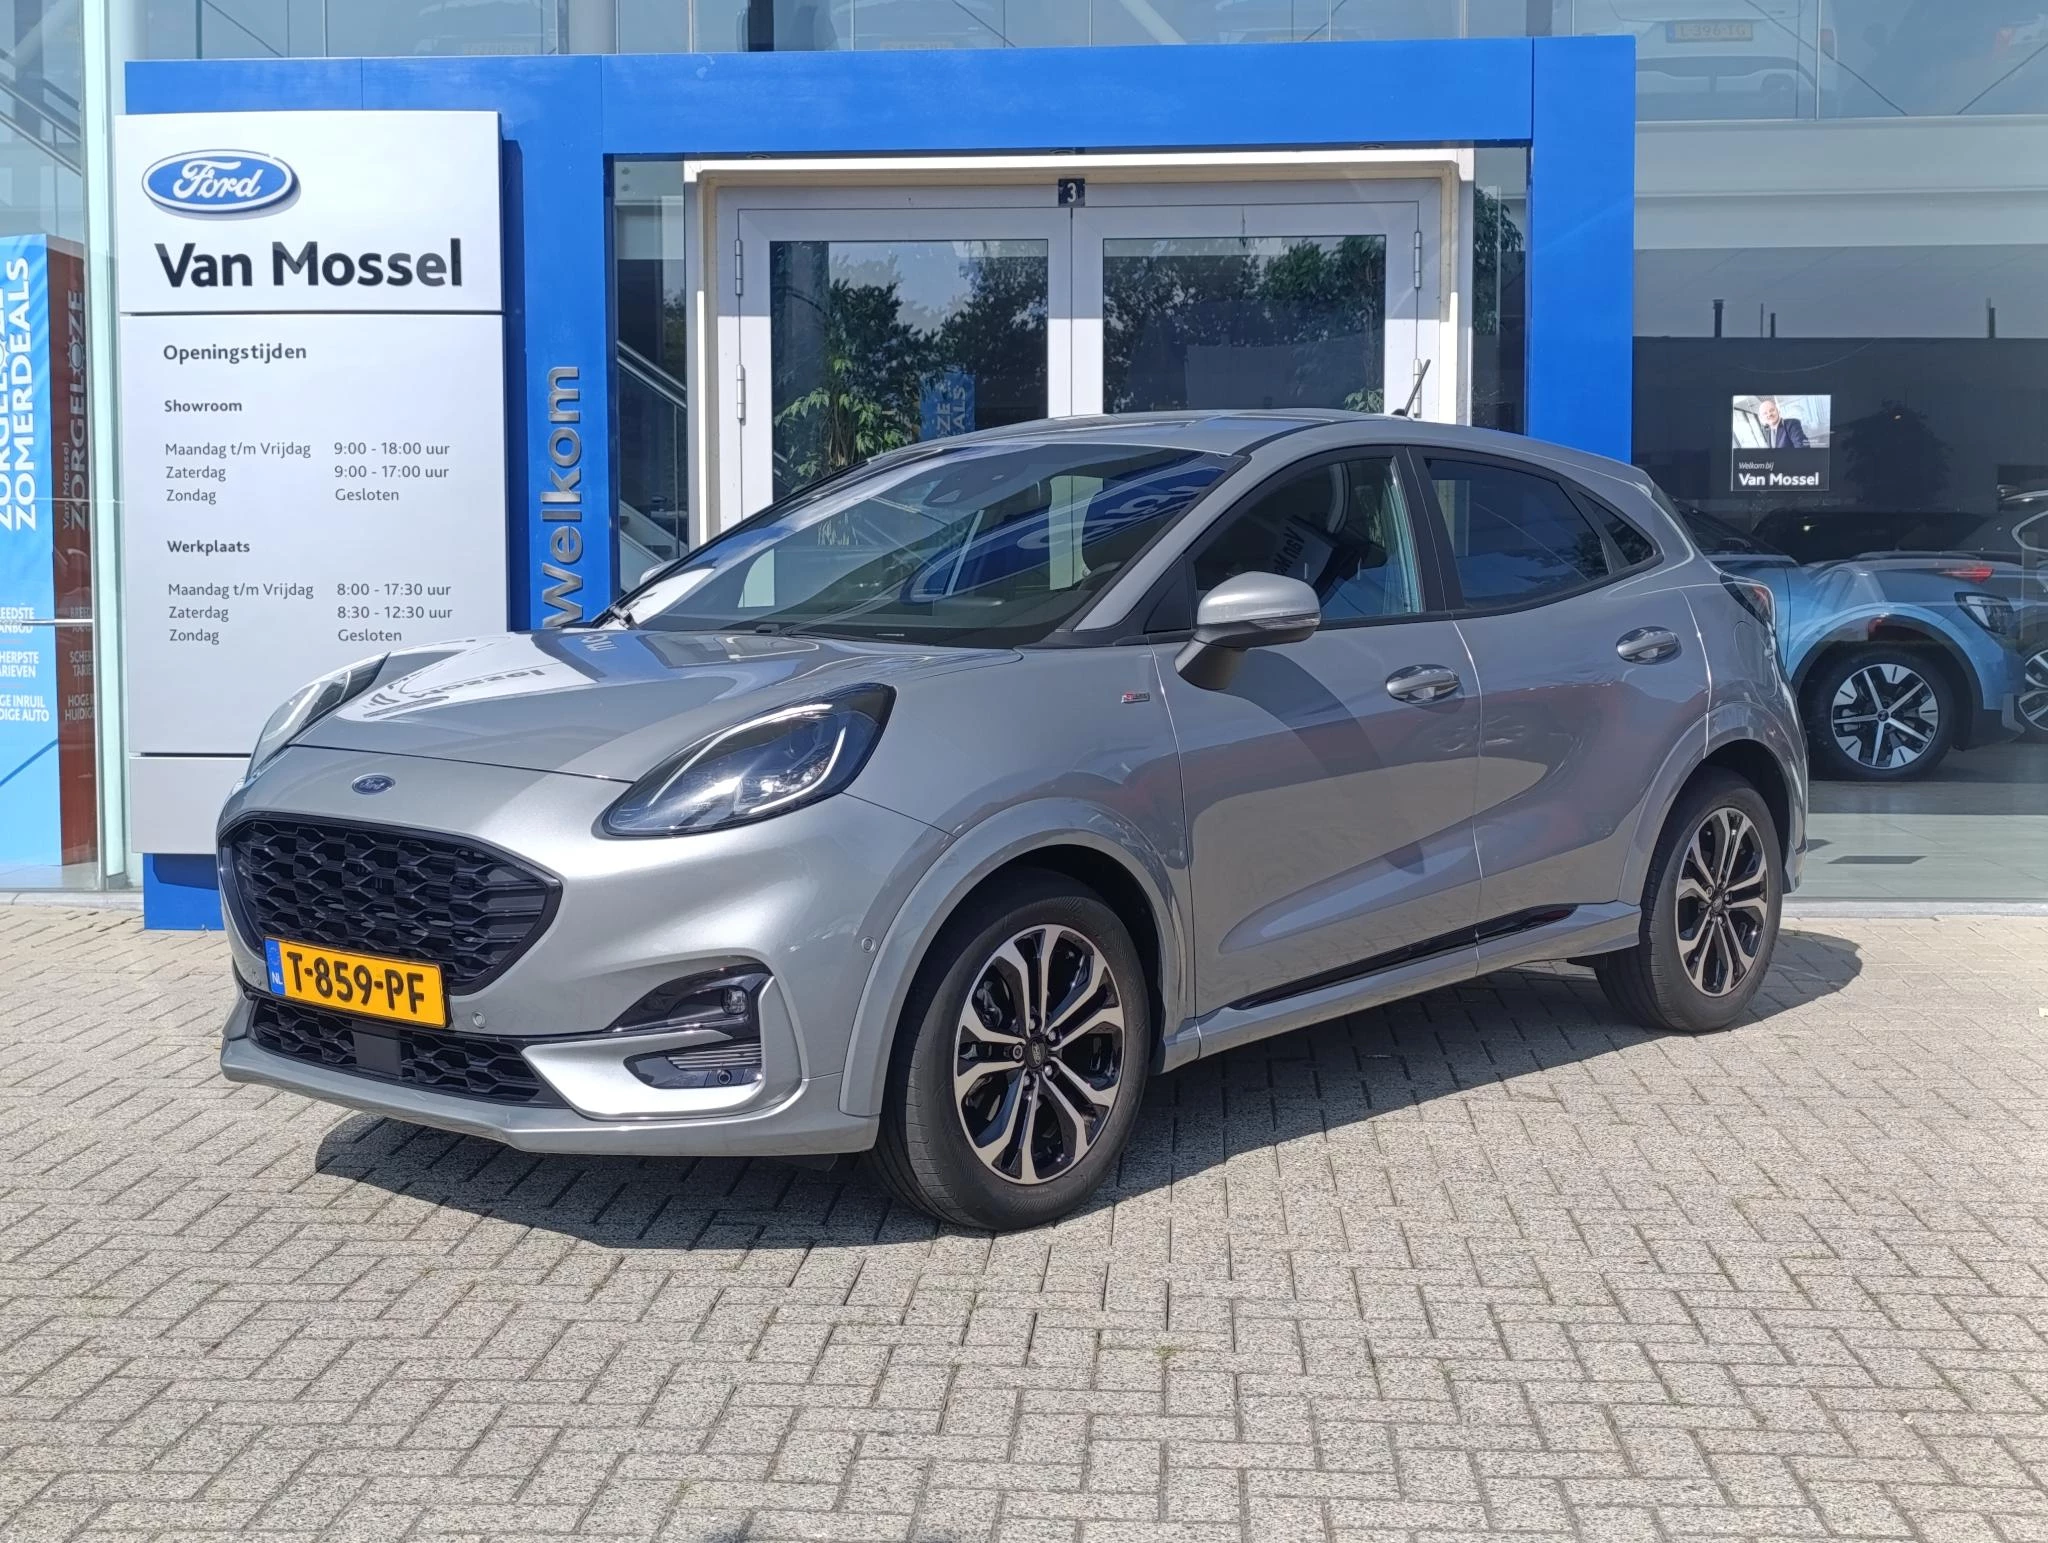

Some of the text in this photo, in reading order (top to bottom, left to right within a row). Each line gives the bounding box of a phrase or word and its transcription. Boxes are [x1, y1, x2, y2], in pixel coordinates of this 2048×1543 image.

[172, 159, 264, 199] Ford
[1067, 182, 1077, 203] 3
[154, 237, 463, 288] Van Mossel
[162, 342, 307, 366] Openingstijden
[6, 257, 37, 531] ZOMERDEALS
[163, 398, 243, 413] Showroom
[164, 441, 227, 460] Maandag
[230, 441, 256, 456] t/m
[260, 441, 312, 460] Vrijdag
[333, 441, 368, 456] 9:00
[380, 441, 422, 456] 18:00
[425, 445, 451, 456] uur
[165, 464, 227, 483] Zaterdag
[334, 464, 368, 479] 9:00
[381, 464, 421, 479] 17:00
[424, 468, 450, 479] uur
[1738, 462, 1765, 470] Welkom
[1738, 472, 1819, 486] Van Mossel
[166, 487, 400, 506] Zondag Gesloten
[540, 366, 584, 631] Welkom
[166, 538, 251, 557] Werkplaats
[167, 581, 230, 600] Maandag
[232, 581, 260, 597] t/m
[262, 582, 315, 600] Vrijdag
[336, 582, 371, 597] 8:00
[383, 582, 424, 597] 17:30
[427, 585, 452, 597] uur
[0, 607, 35, 620] EEDSTE
[168, 604, 230, 623] Zaterdag
[337, 605, 371, 620] 8:30
[383, 605, 425, 620] 12:30
[428, 608, 454, 620] uur
[168, 627, 403, 646] Zondag Gesloten
[22, 709, 49, 722] AUTO
[271, 970, 284, 985] NL
[286, 950, 426, 1015] T-859-PF
